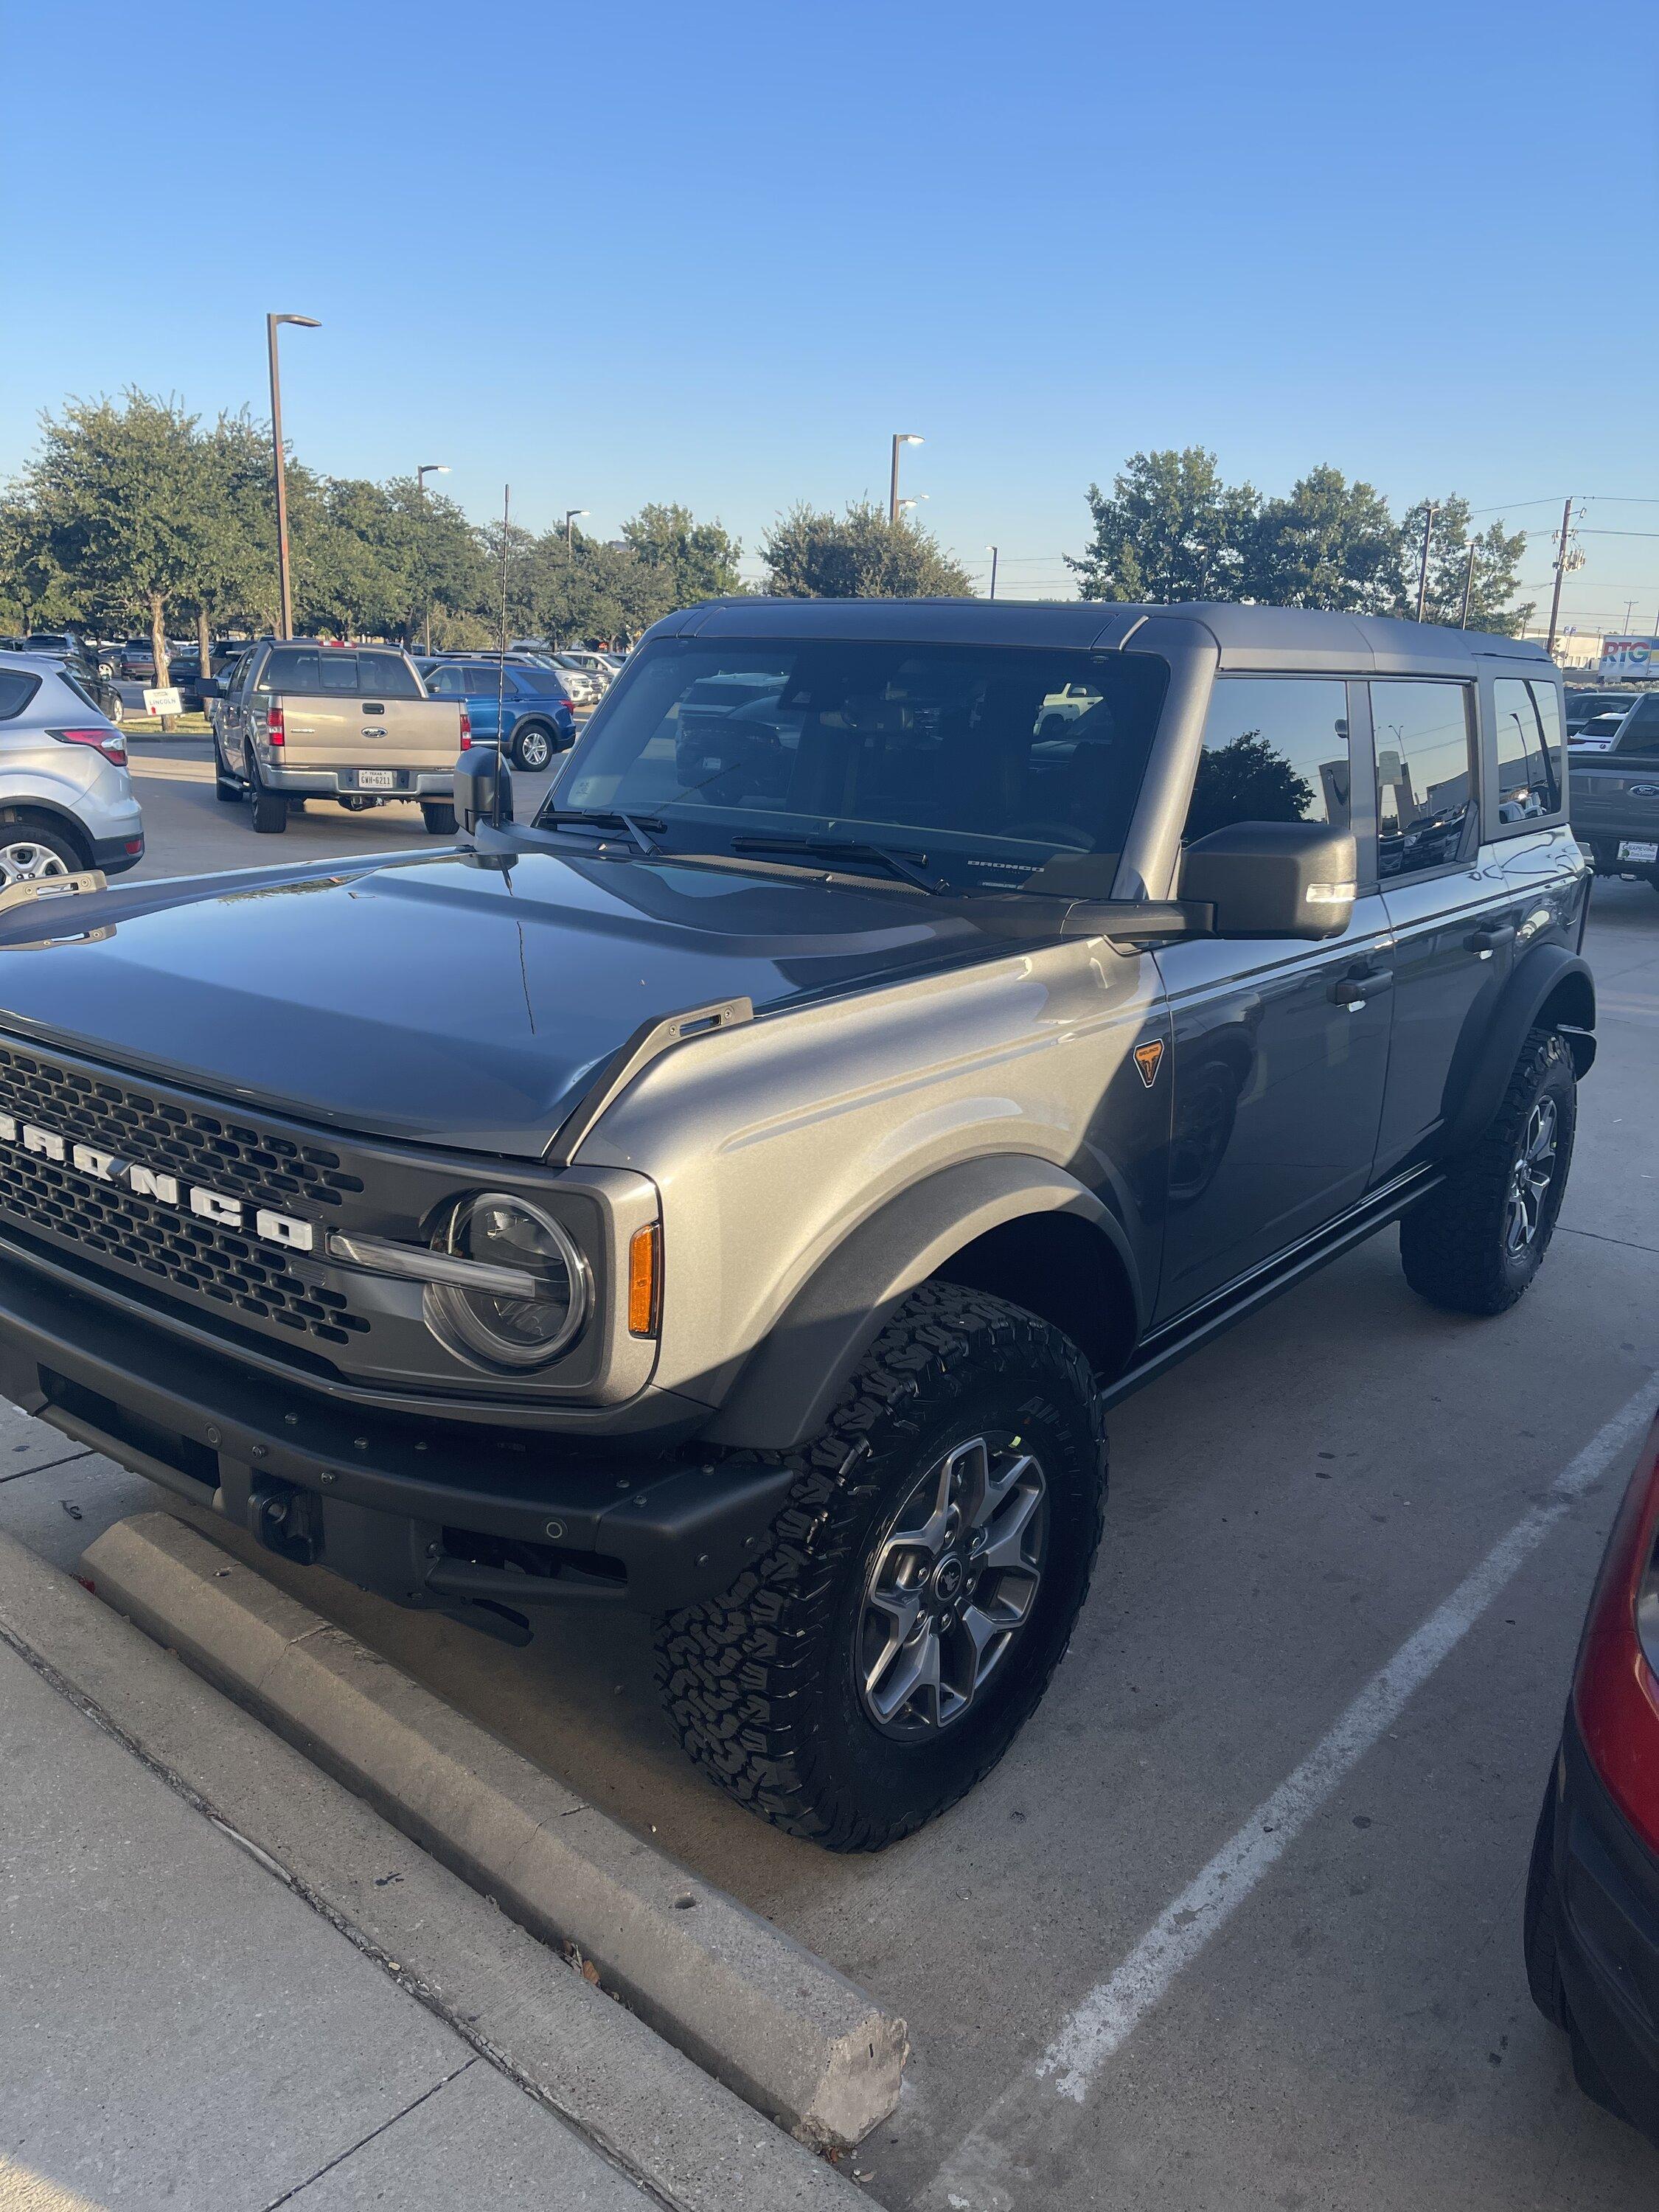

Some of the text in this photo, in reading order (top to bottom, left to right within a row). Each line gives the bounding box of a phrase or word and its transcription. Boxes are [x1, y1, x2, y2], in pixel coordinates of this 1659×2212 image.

[1602, 642, 1650, 663] RTG
[1636, 787, 1656, 796] Ford
[967, 860, 1044, 872] BRONCO
